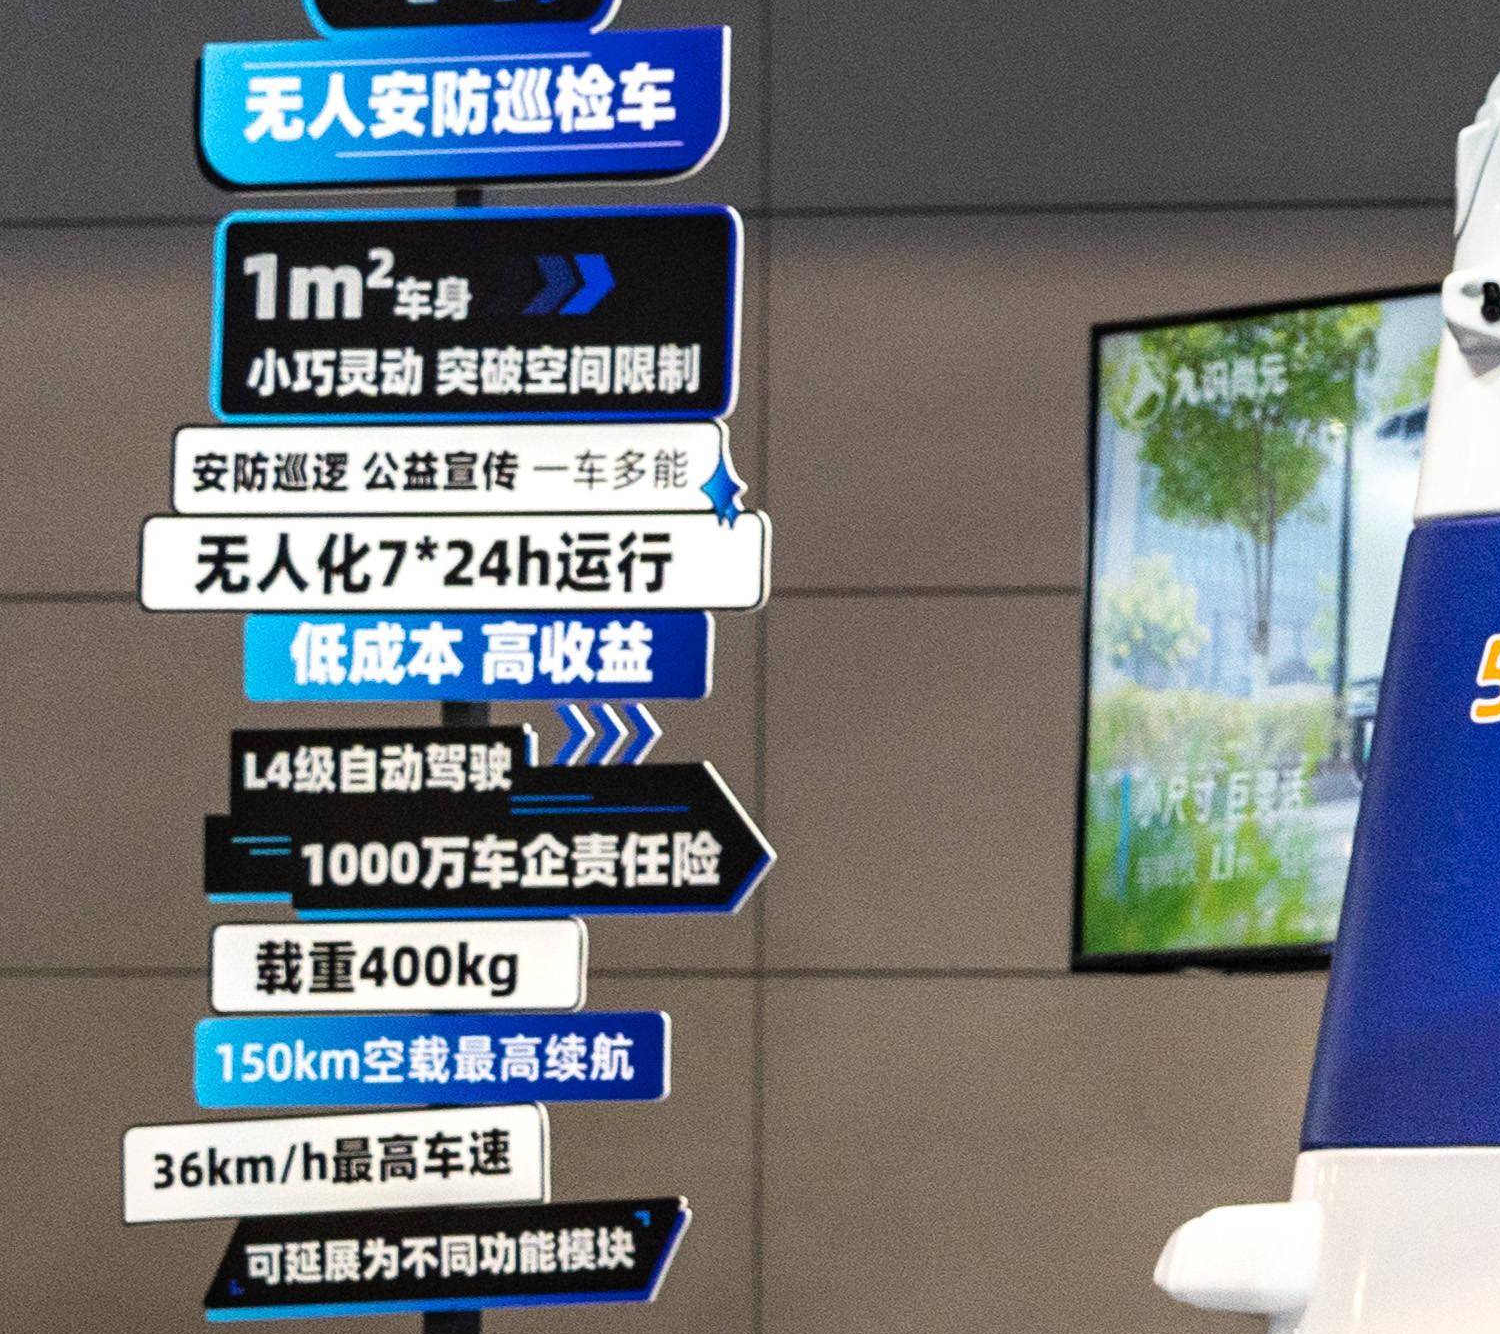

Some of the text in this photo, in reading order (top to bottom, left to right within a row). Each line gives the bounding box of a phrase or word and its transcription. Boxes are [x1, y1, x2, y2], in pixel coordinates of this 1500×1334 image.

[243, 63, 677, 144] 无人安防巡检车
[247, 343, 701, 397] 小巧灵动 突破空间限制
[192, 448, 689, 493] 安防巡逻 公益宣传 一车多能
[290, 620, 653, 686] 低成本 高收益
[243, 743, 513, 795] L4级自动驾驶
[302, 832, 722, 891] 1000万车企责任险
[255, 939, 519, 999] 载重400kg
[215, 1031, 635, 1086] 150km空载最高续航
[153, 1127, 513, 1190] 36km/h最高车速
[245, 1225, 636, 1287] 可延展为不同功能模块
